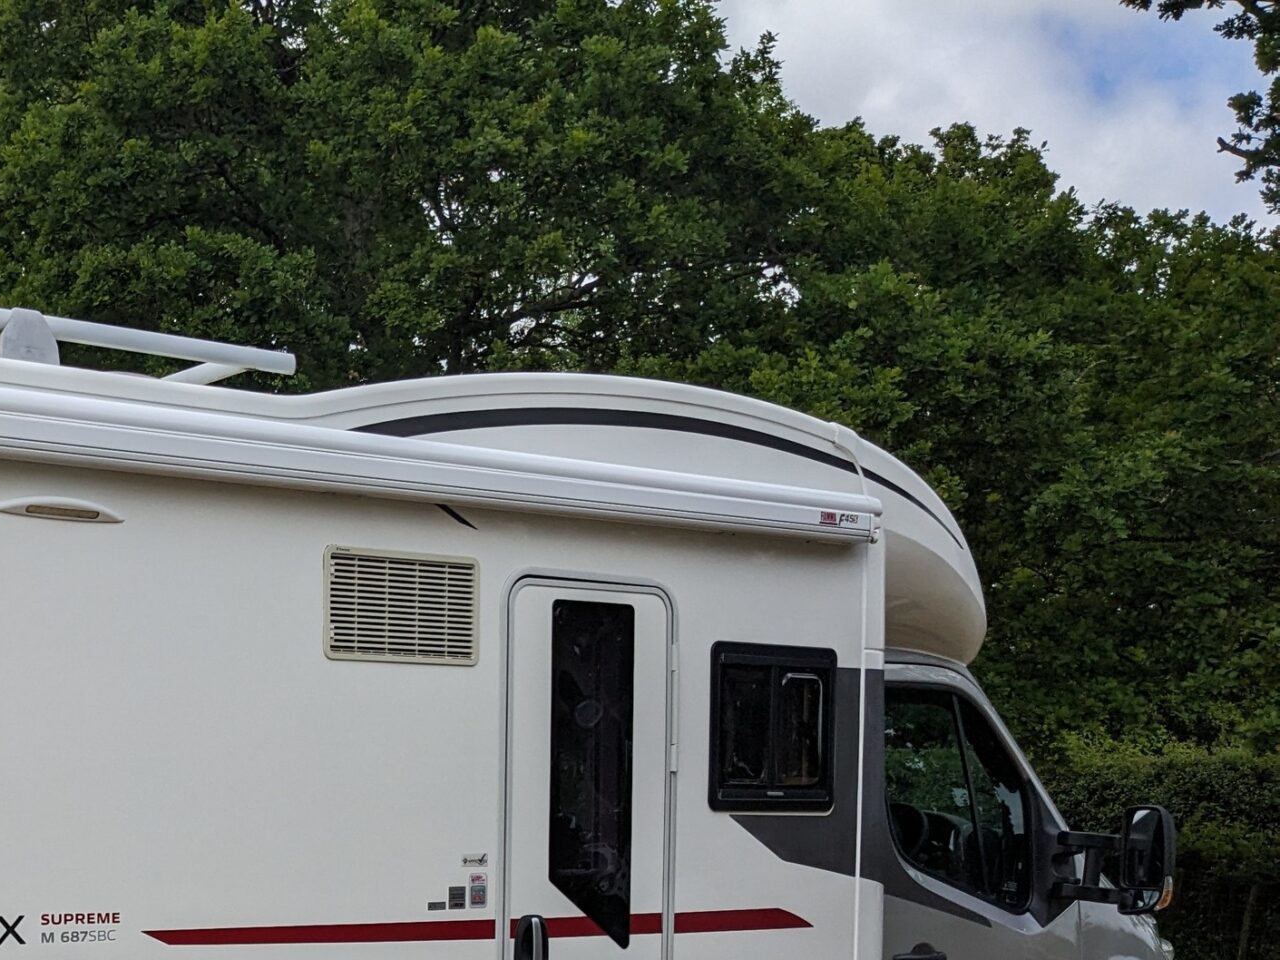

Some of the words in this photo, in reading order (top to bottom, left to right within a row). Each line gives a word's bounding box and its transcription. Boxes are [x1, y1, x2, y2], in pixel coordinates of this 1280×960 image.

[40, 912, 121, 926] SUPREME
[41, 932, 55, 944] M
[60, 929, 117, 943] 687SBC
